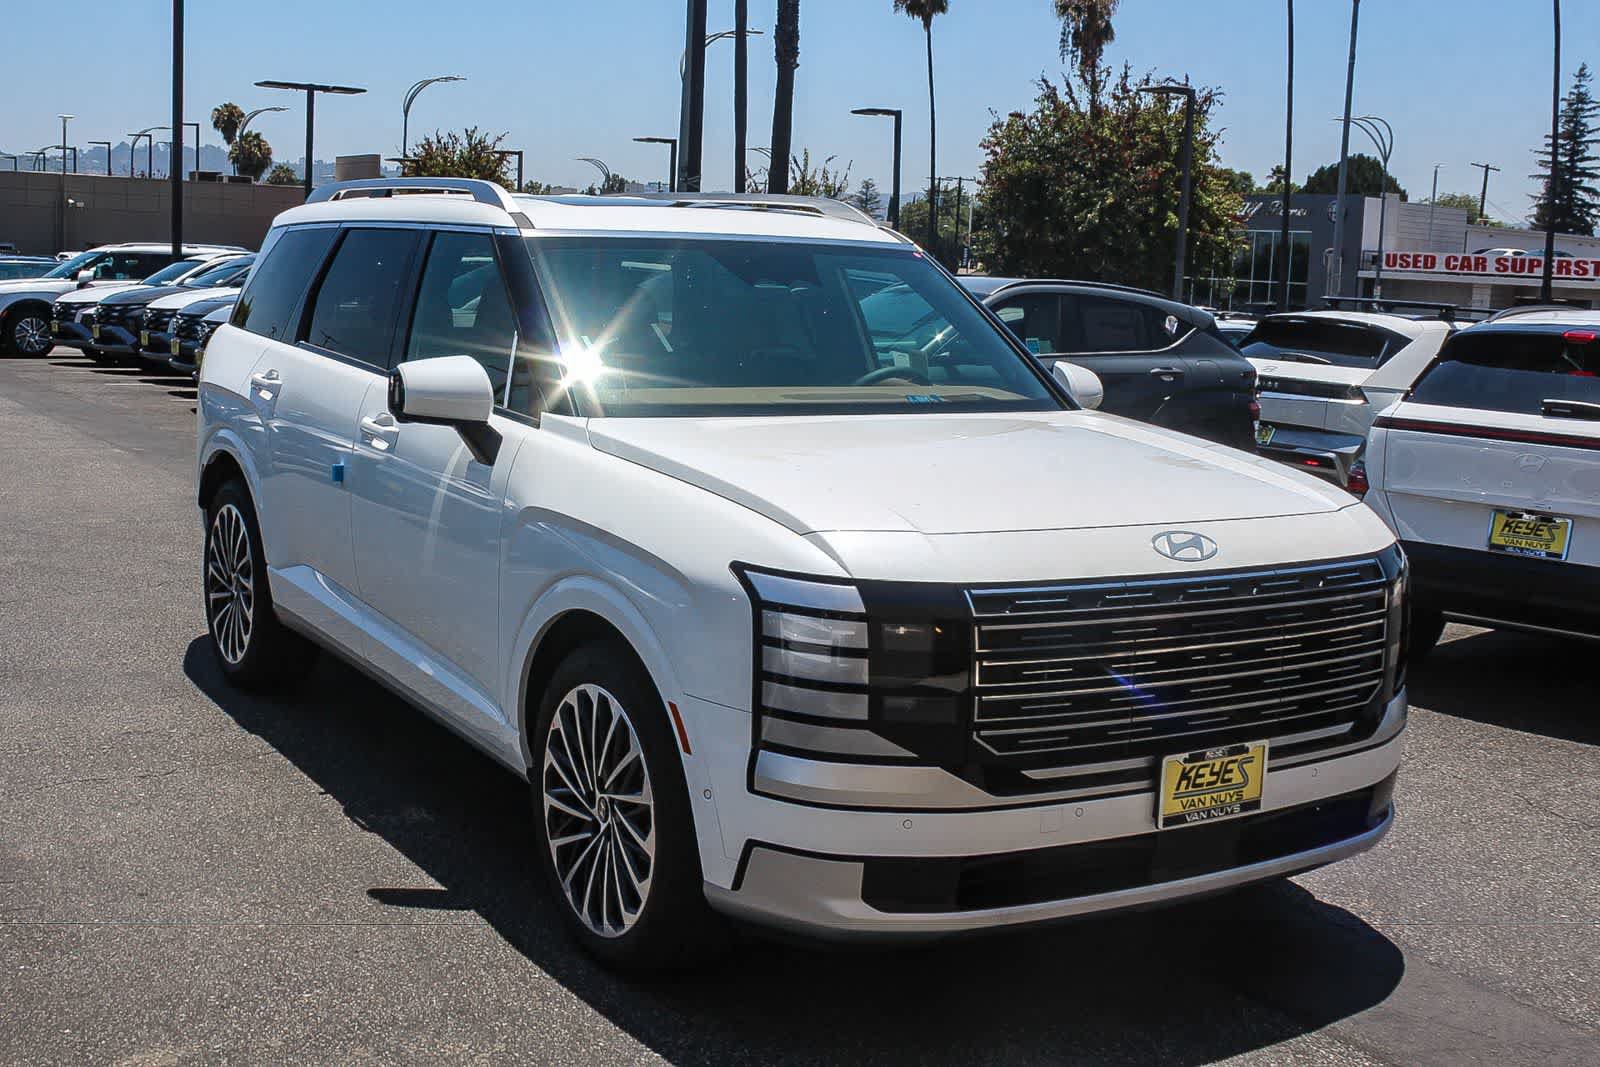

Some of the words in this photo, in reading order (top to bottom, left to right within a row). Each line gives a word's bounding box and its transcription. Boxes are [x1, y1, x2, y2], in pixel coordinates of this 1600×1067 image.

[1384, 252, 1437, 269] USED
[1444, 255, 1489, 273] CAR
[1494, 256, 1600, 277] SUPRST
[1501, 518, 1560, 541] KEYES
[1503, 537, 1522, 547] VAN
[1525, 540, 1552, 551] NUYS
[1174, 756, 1255, 792] KEYES
[1180, 796, 1206, 810] VAN
[1210, 790, 1244, 804] NUYS
[1185, 811, 1208, 823] VAN
[1210, 804, 1240, 817] NUYS
